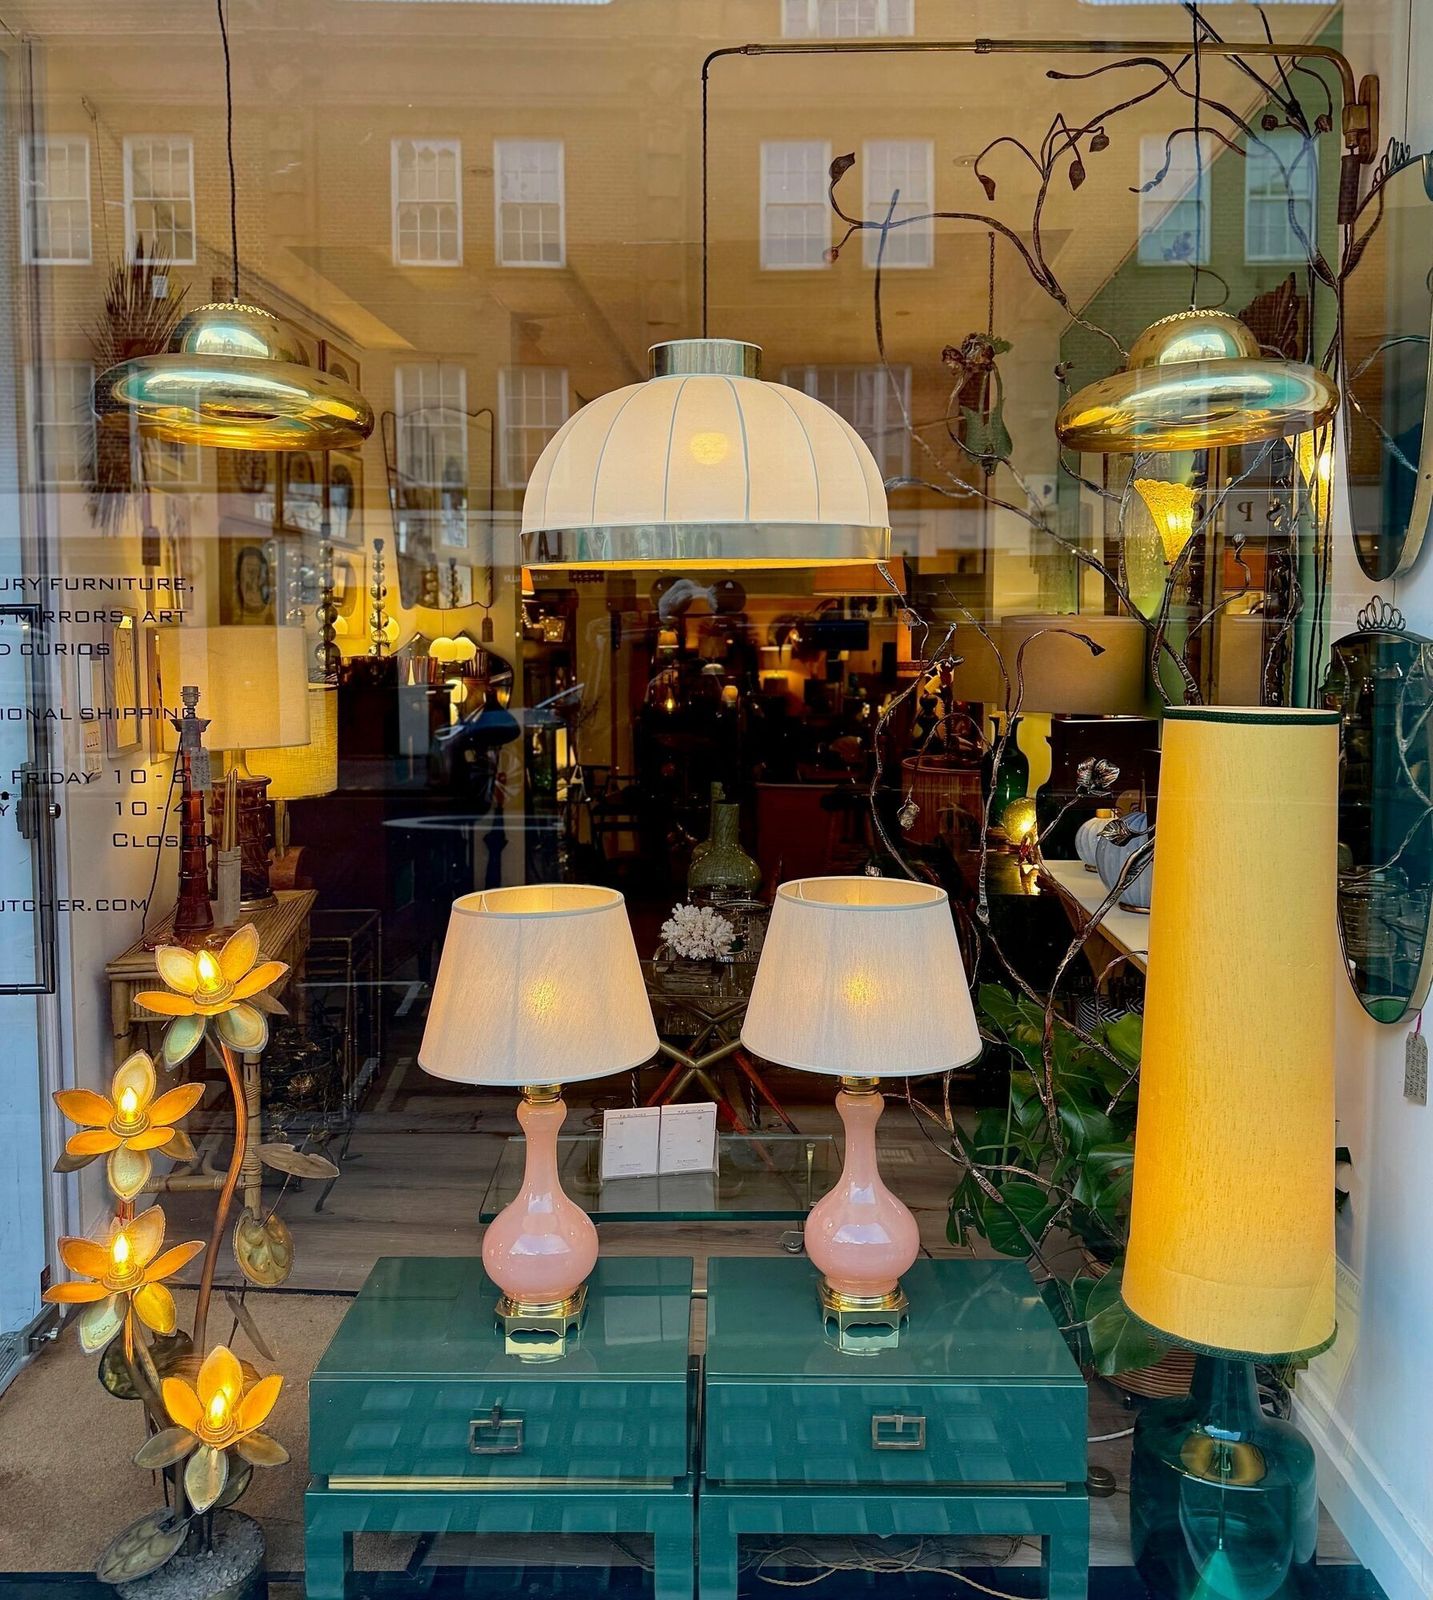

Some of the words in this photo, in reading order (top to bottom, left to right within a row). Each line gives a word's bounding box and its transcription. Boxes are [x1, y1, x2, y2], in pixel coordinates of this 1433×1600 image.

[51, 577, 194, 593] FURNITURE,
[142, 610, 188, 623] ART
[20, 643, 110, 656] CURIOS
[0, 708, 72, 720] IONAL
[80, 707, 196, 720] SHIPPING
